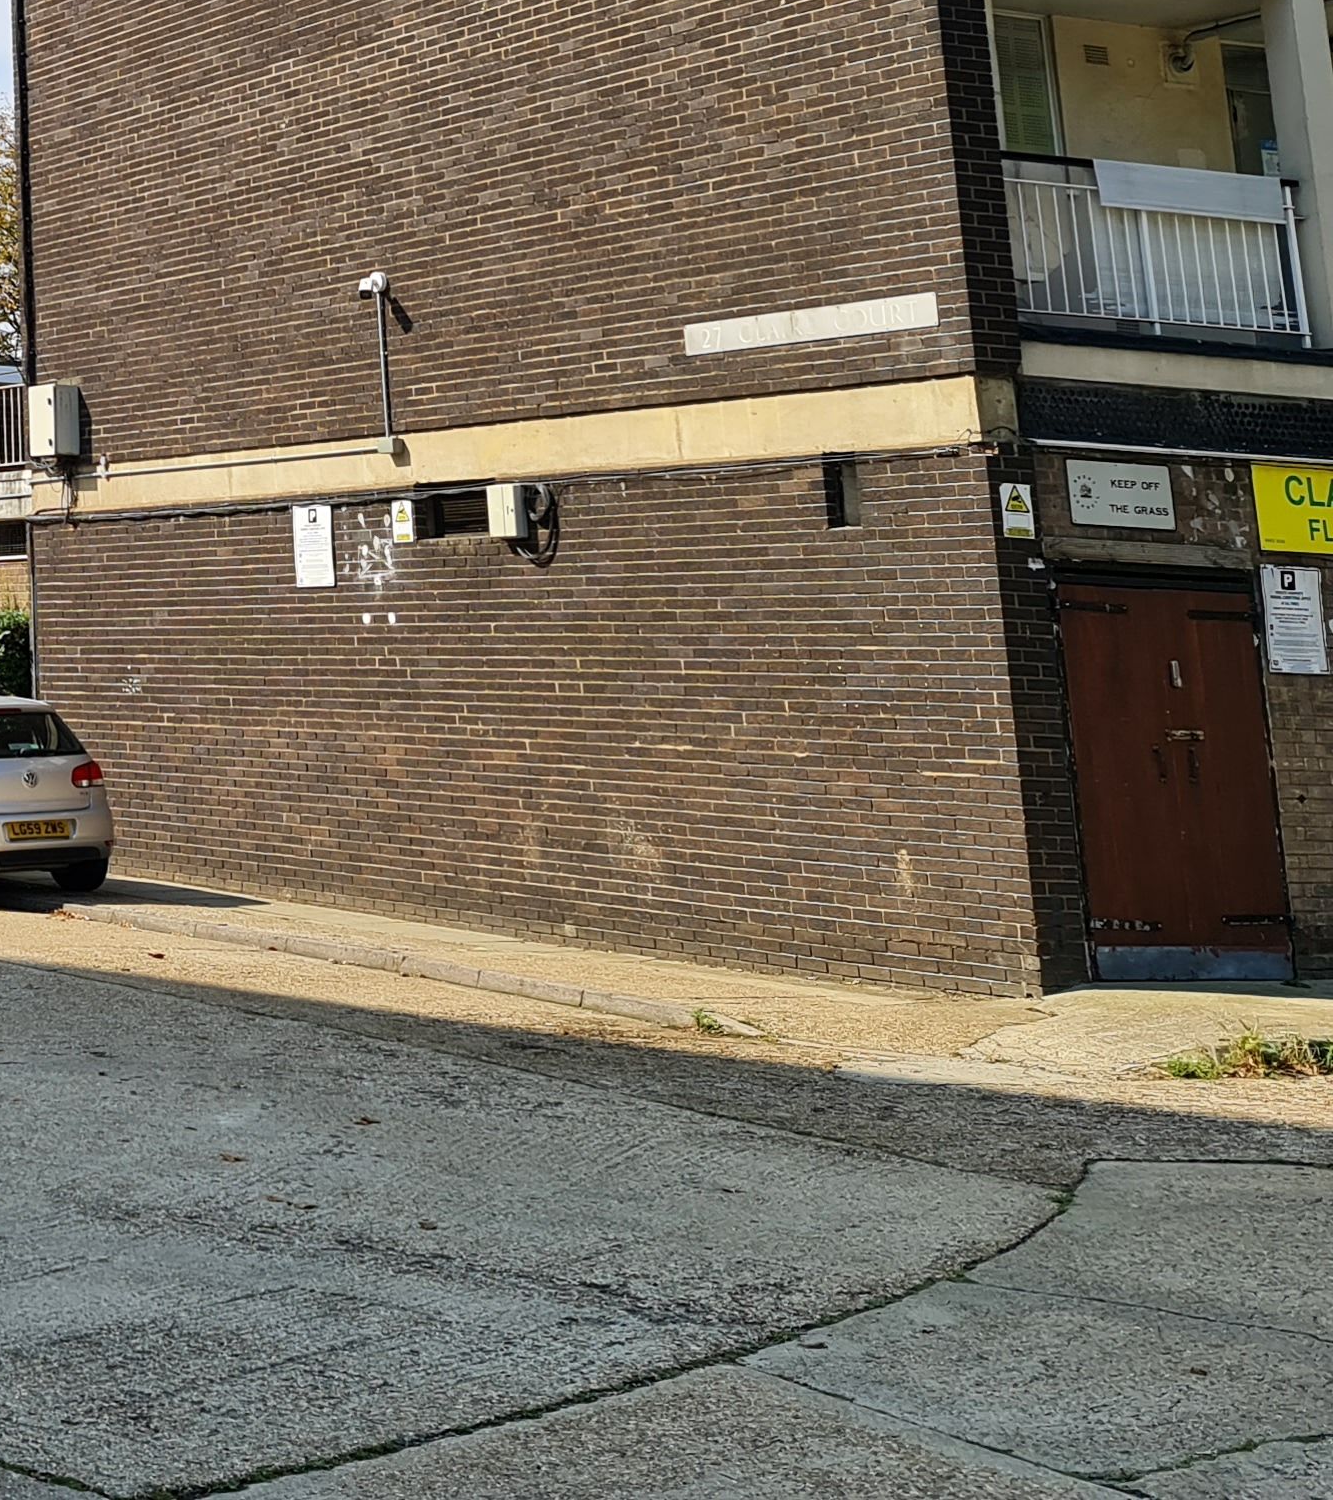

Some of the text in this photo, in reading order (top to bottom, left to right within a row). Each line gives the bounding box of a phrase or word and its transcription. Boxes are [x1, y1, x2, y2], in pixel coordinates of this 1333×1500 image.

[701, 326, 721, 349] 27
[834, 300, 917, 331] COURT
[1110, 479, 1160, 491] KEEP OFF
[1284, 475, 1333, 508] CL
[1109, 504, 1169, 516] THE GRASS
[11, 822, 41, 836] LG59
